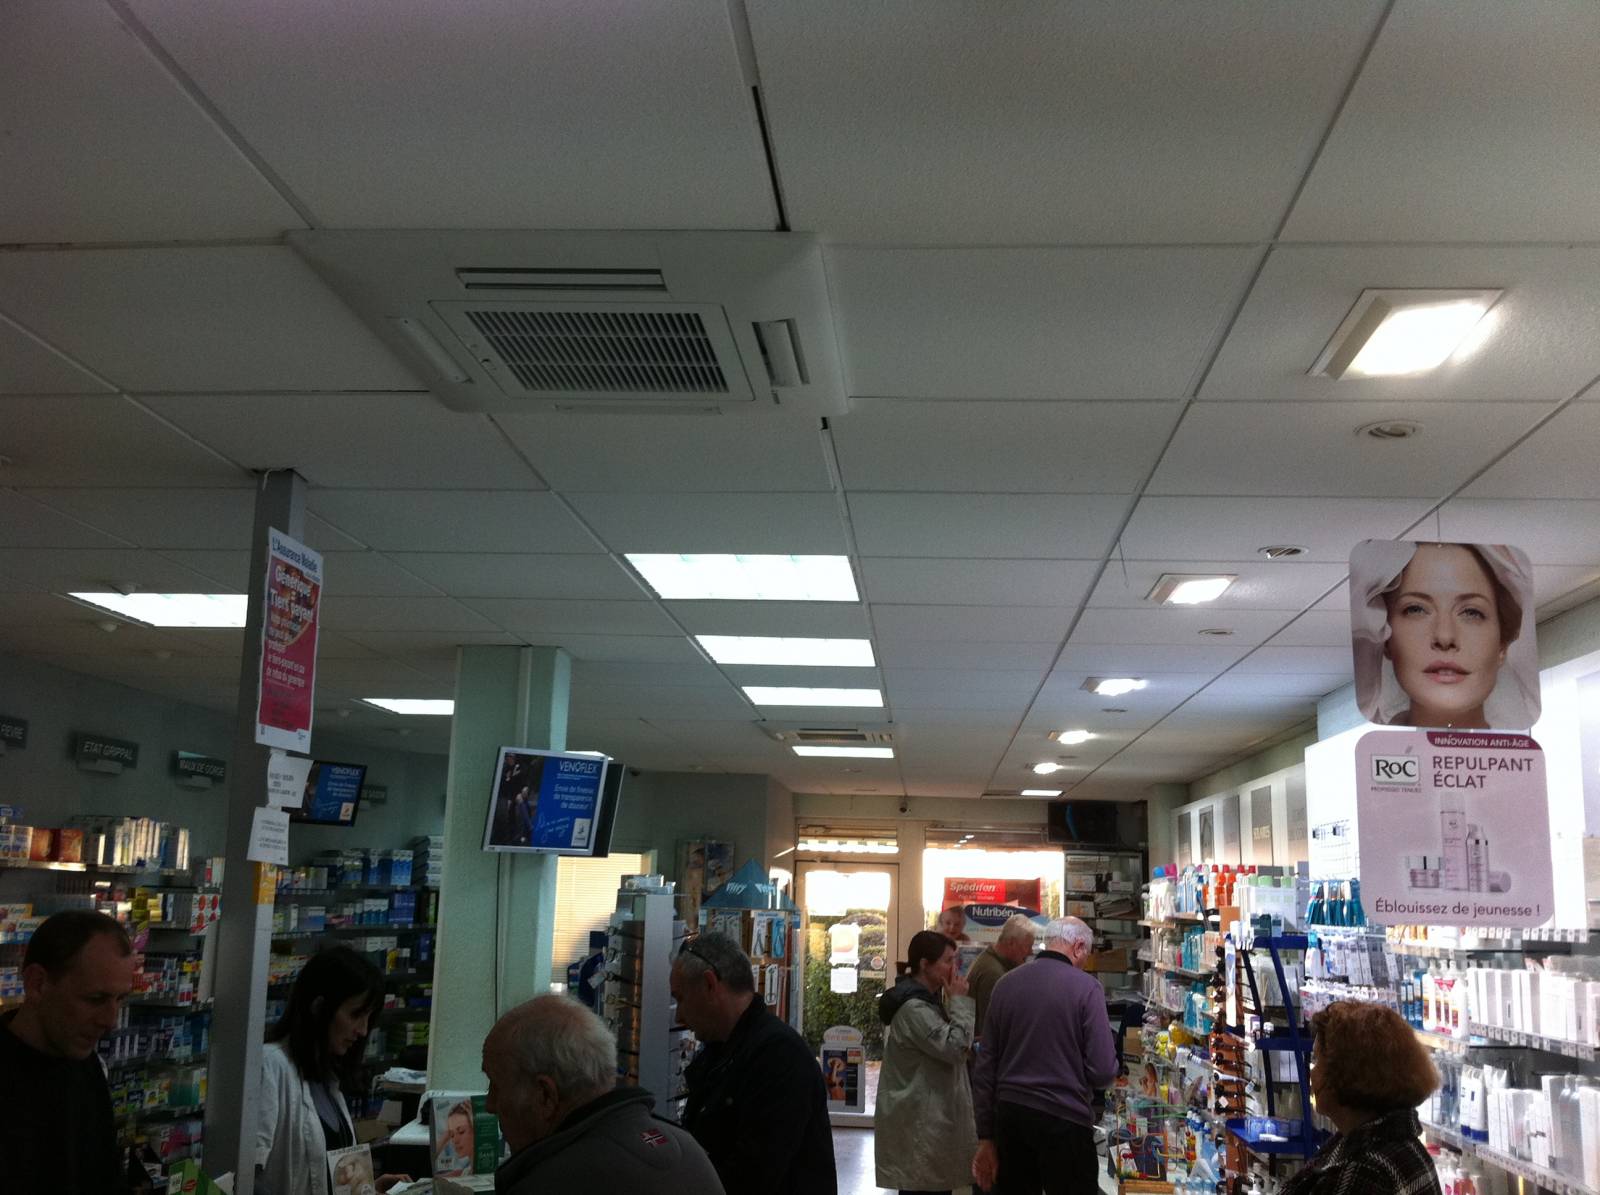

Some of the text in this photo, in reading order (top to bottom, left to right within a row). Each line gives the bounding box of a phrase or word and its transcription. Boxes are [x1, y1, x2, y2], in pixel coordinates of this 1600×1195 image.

[1434, 736, 1488, 746] INNOVATION
[1432, 755, 1534, 772] REPULPANT
[1433, 770, 1487, 789] ÉCLAT
[1375, 898, 1541, 918] Éblouissez de jeunesse !
